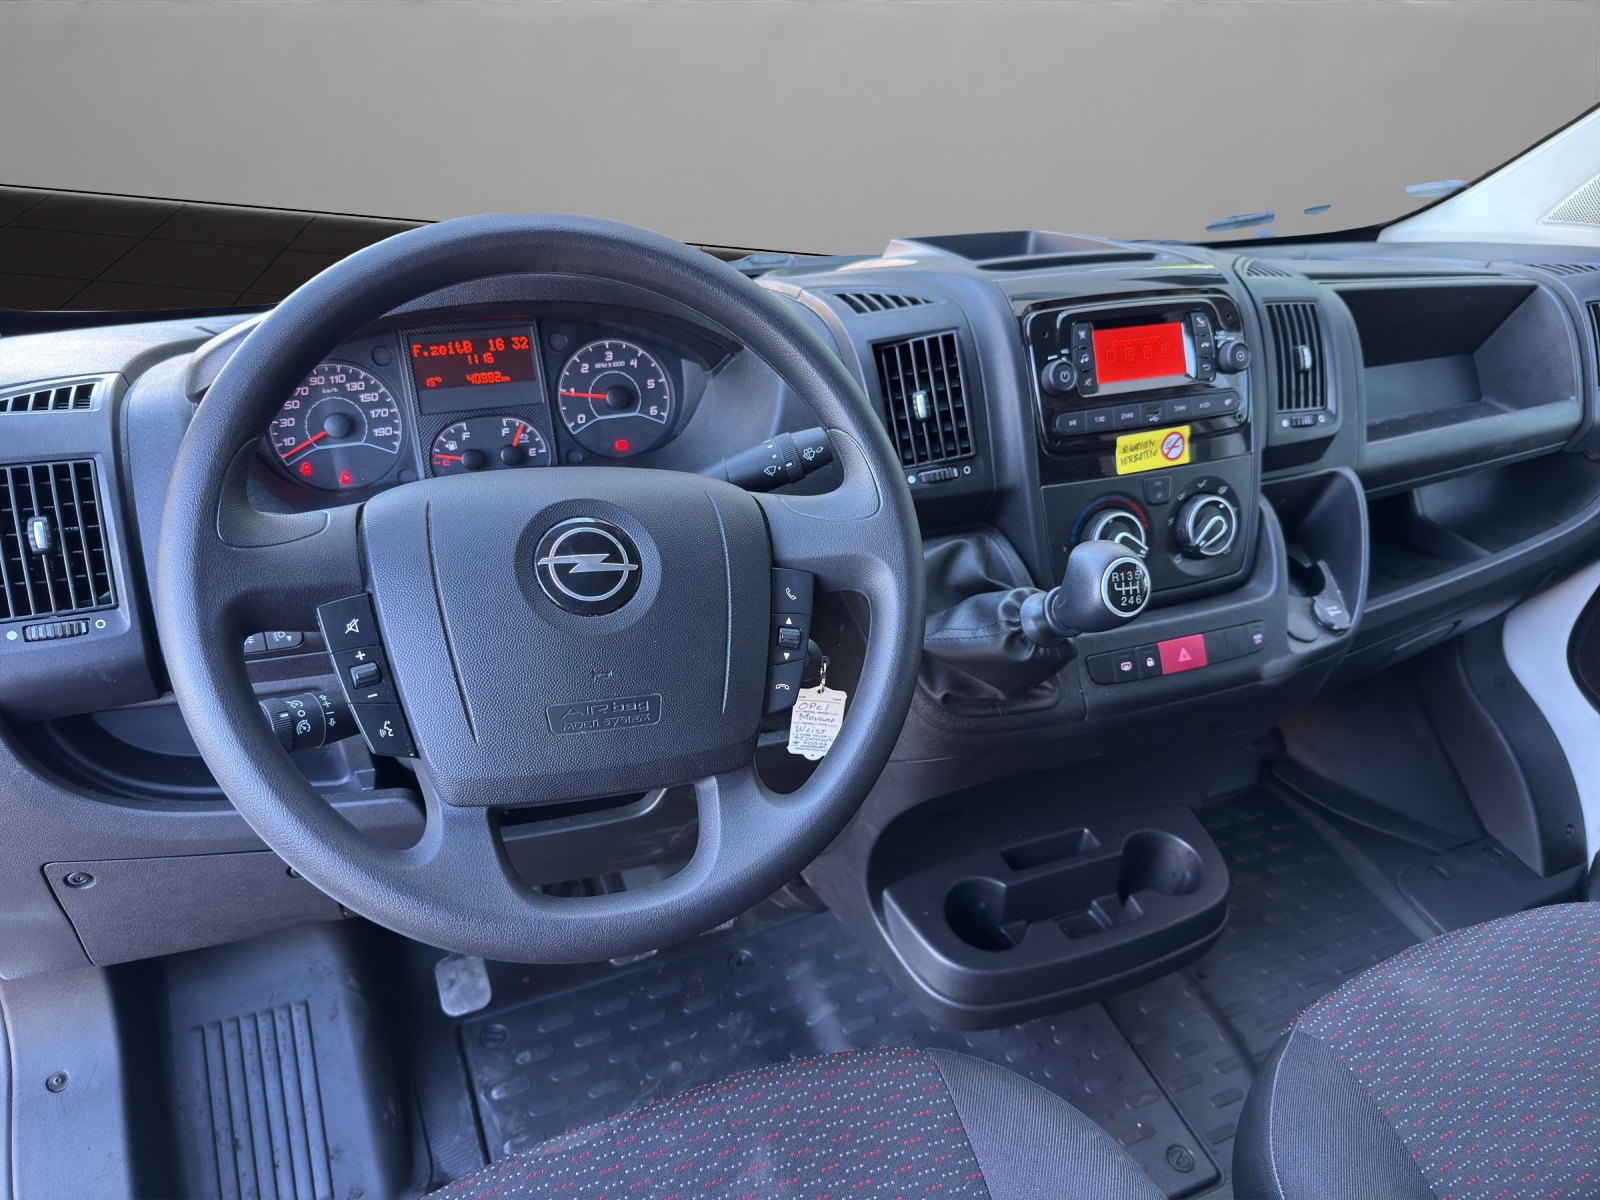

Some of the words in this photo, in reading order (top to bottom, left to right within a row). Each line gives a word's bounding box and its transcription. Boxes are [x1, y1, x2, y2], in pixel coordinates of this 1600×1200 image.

[511, 336, 529, 350] 32
[604, 351, 613, 361] 3
[580, 363, 589, 373] 2
[630, 358, 638, 368] 4
[310, 376, 325, 386] 90
[329, 374, 346, 384] 110
[647, 379, 655, 389] 5
[346, 381, 365, 391] 130
[294, 387, 309, 396] 70
[359, 393, 379, 403] 150
[284, 400, 300, 410] 50
[370, 408, 389, 418] 170
[650, 406, 658, 415] 6
[280, 418, 295, 427] 30
[577, 414, 586, 423] 0
[373, 427, 393, 437] 190
[462, 432, 470, 441] F
[502, 428, 510, 437] F
[283, 437, 295, 446] 10
[1122, 440, 1155, 454] RAUCHEN
[529, 448, 537, 457] E
